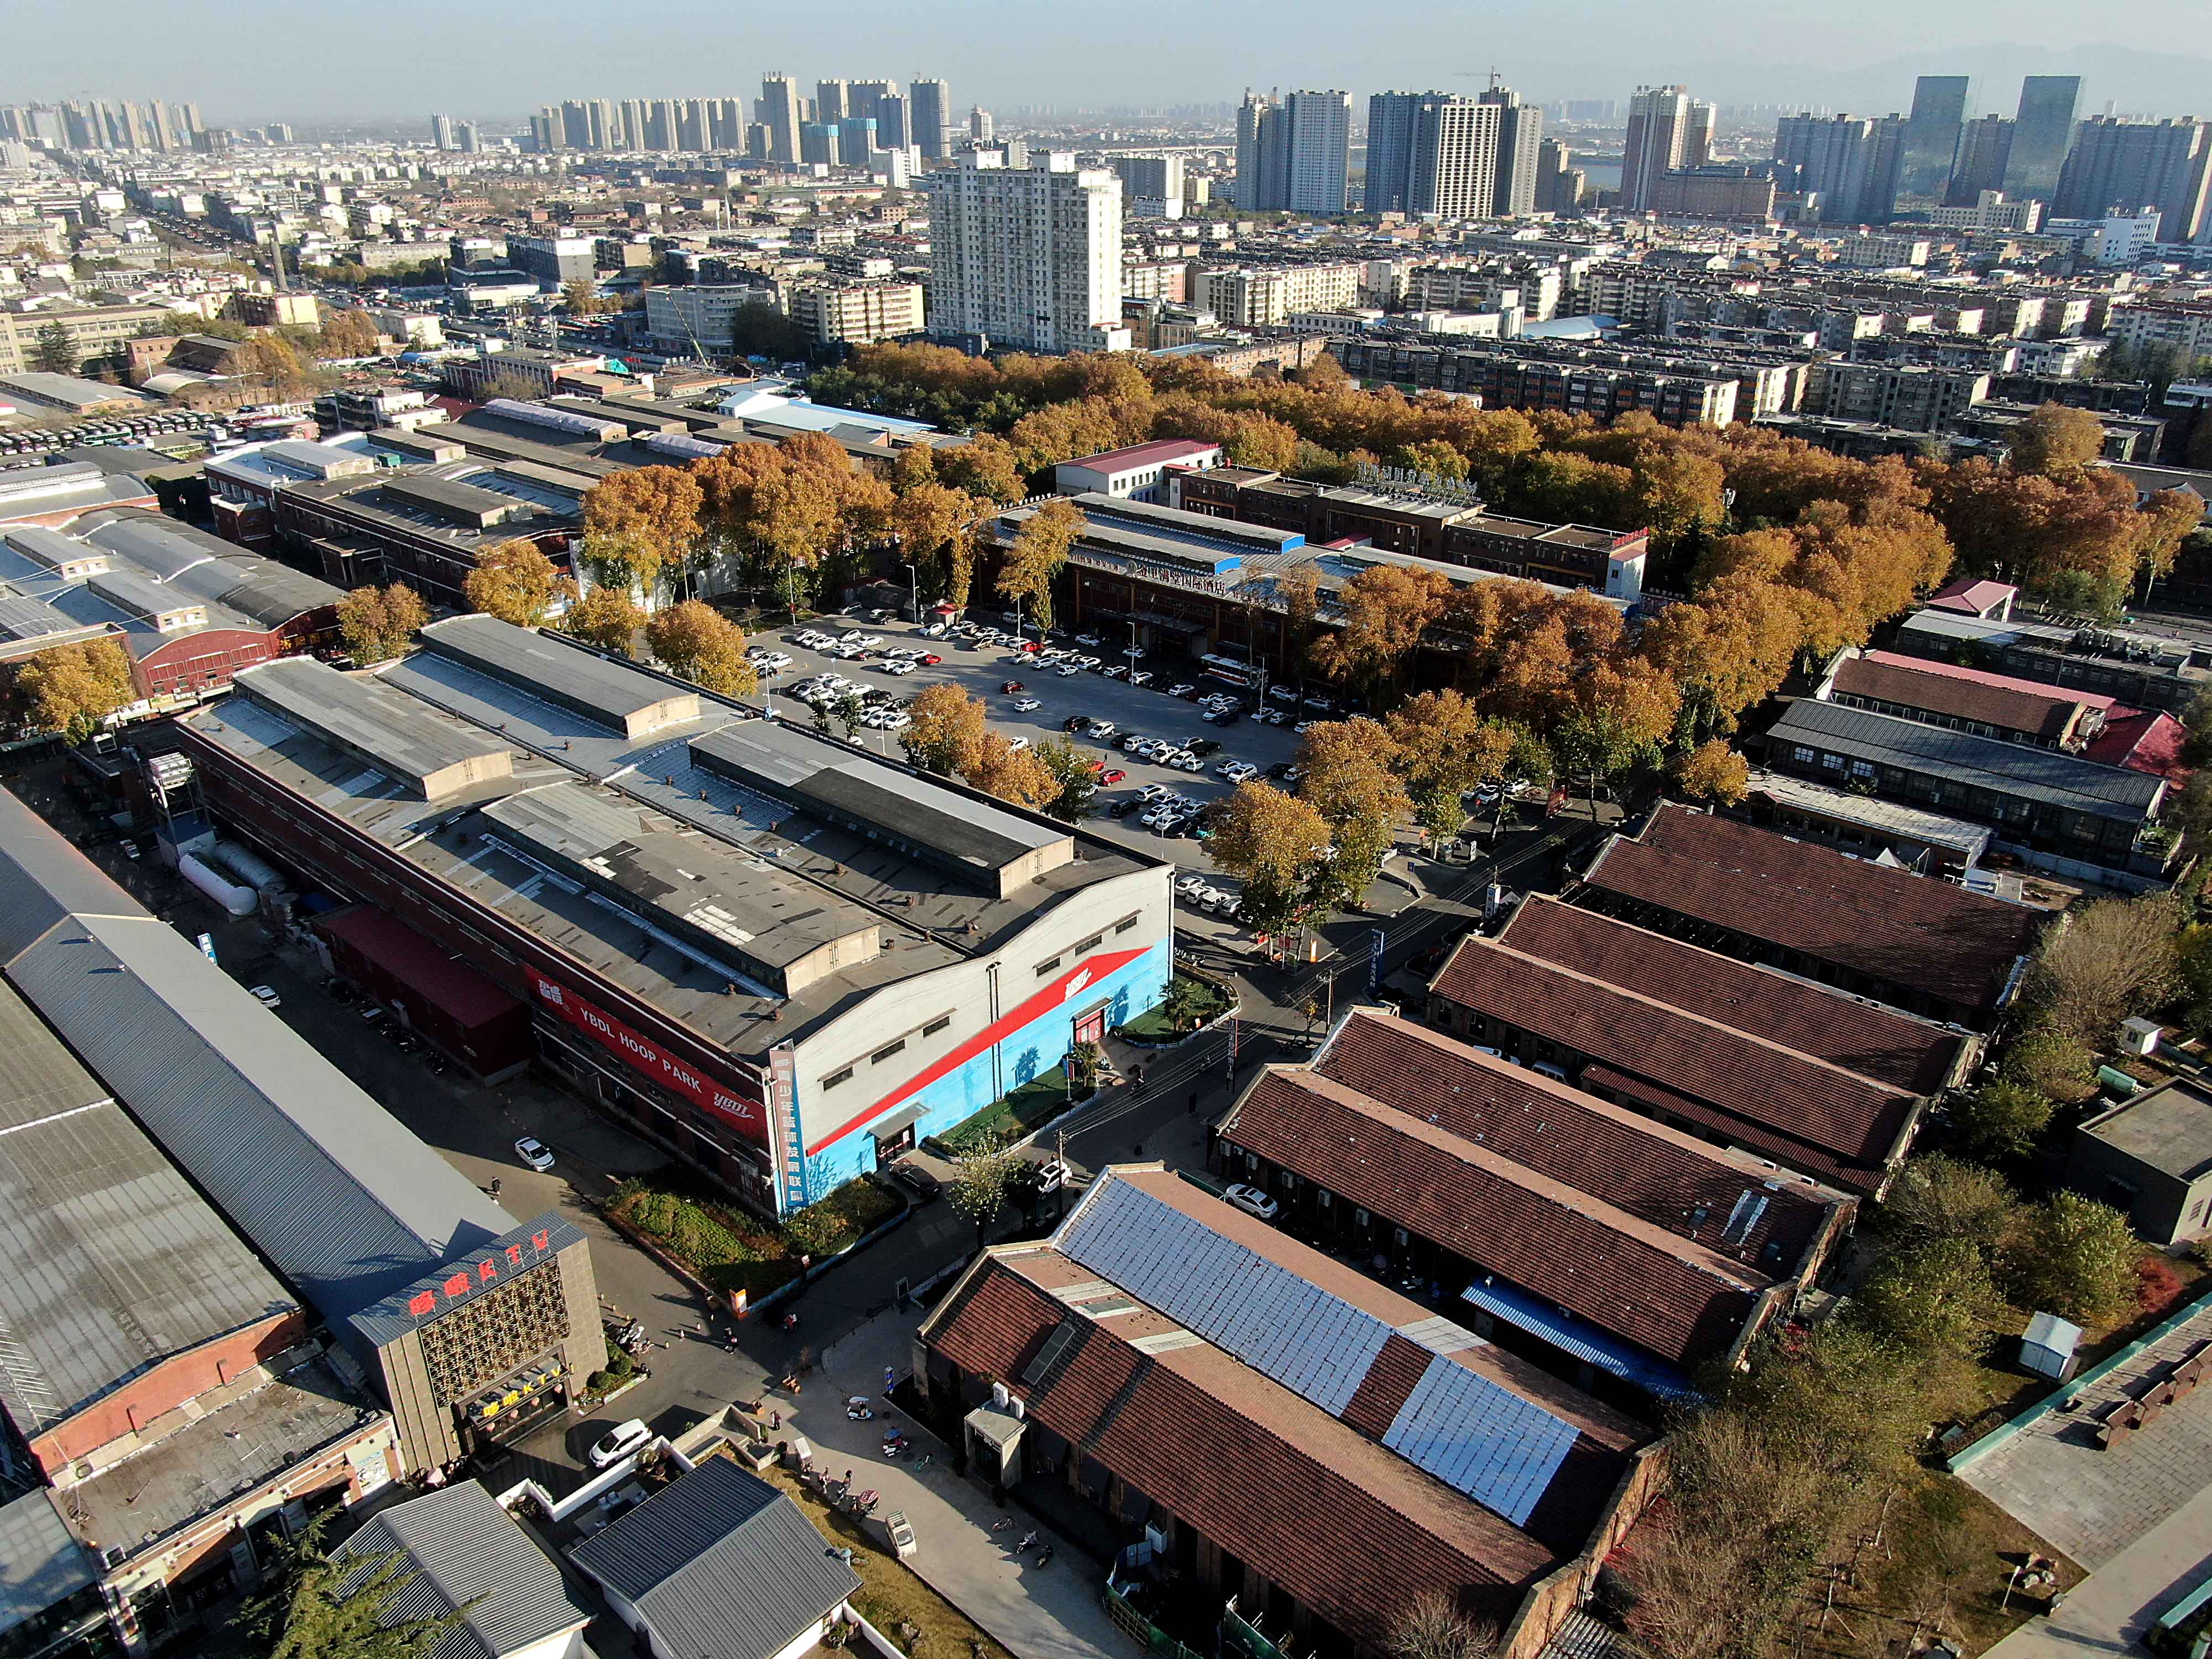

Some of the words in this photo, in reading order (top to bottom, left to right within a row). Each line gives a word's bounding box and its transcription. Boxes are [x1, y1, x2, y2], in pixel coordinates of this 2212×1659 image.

[580, 1006, 615, 1039] YBDL
[619, 1031, 656, 1062] HOOP
[662, 1059, 703, 1094] PARK
